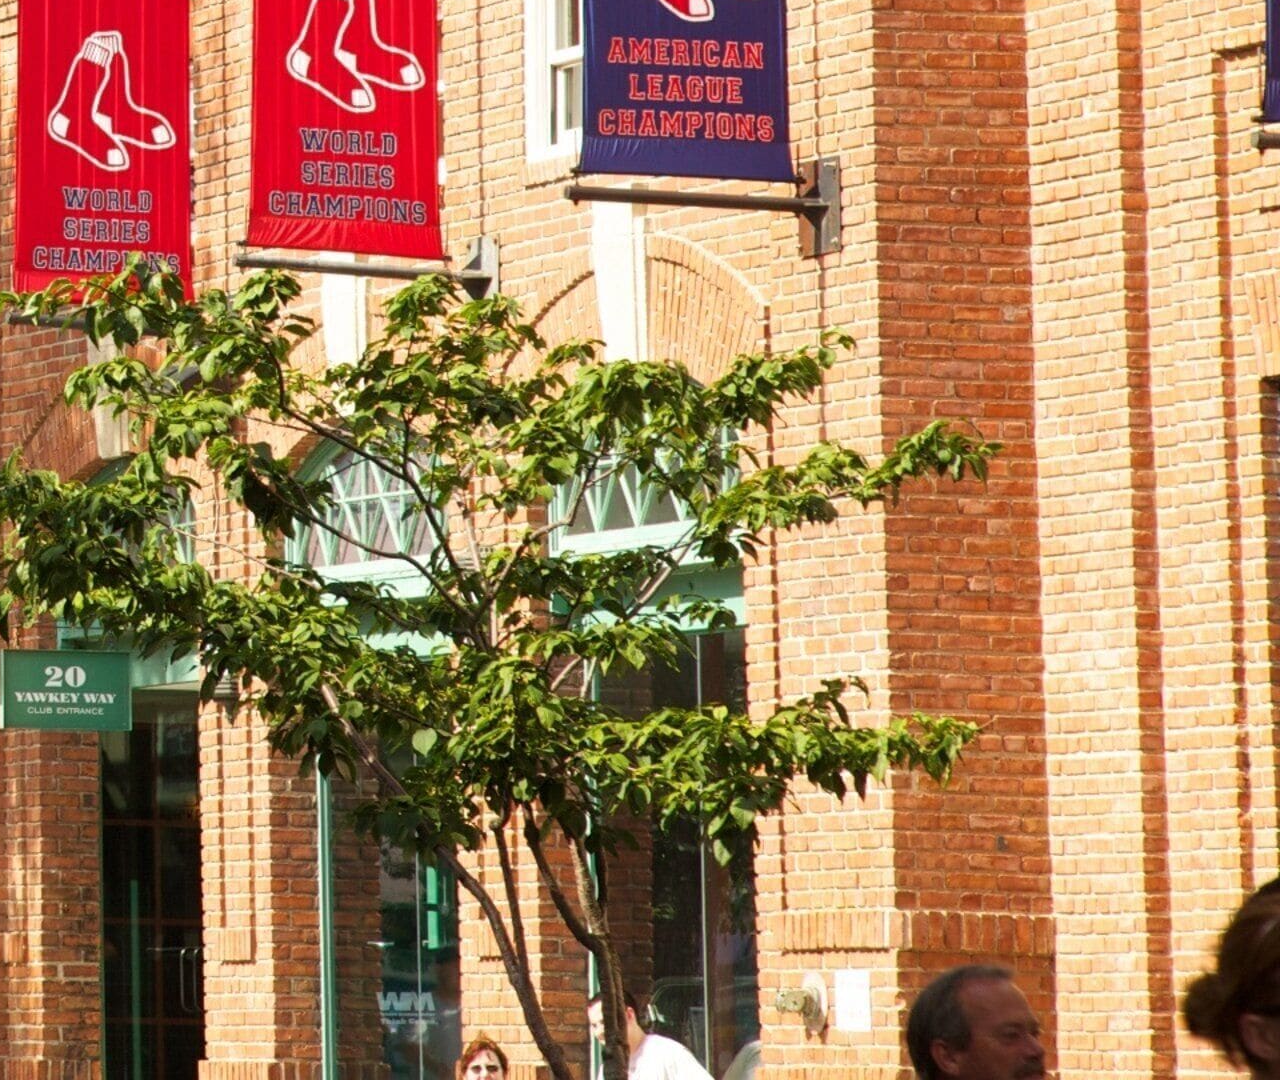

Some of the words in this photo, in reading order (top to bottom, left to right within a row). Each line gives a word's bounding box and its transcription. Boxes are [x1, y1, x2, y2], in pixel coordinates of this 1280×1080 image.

[607, 37, 765, 69] AMERICAN
[628, 74, 744, 104] LEAGUE
[598, 109, 775, 143] CHAMPIONS
[299, 127, 398, 157] WORLD
[301, 161, 395, 189] SERIES
[61, 186, 153, 212] WORLD
[269, 190, 427, 224] CHAMPIONS
[64, 218, 151, 243] SERIES
[32, 246, 181, 276] CHAMPINS
[44, 666, 86, 688] 20
[14, 691, 80, 703] YAWKEY
[84, 693, 117, 704] WAY
[27, 706, 53, 714] CLUB
[56, 707, 104, 715] ENTRANCE
